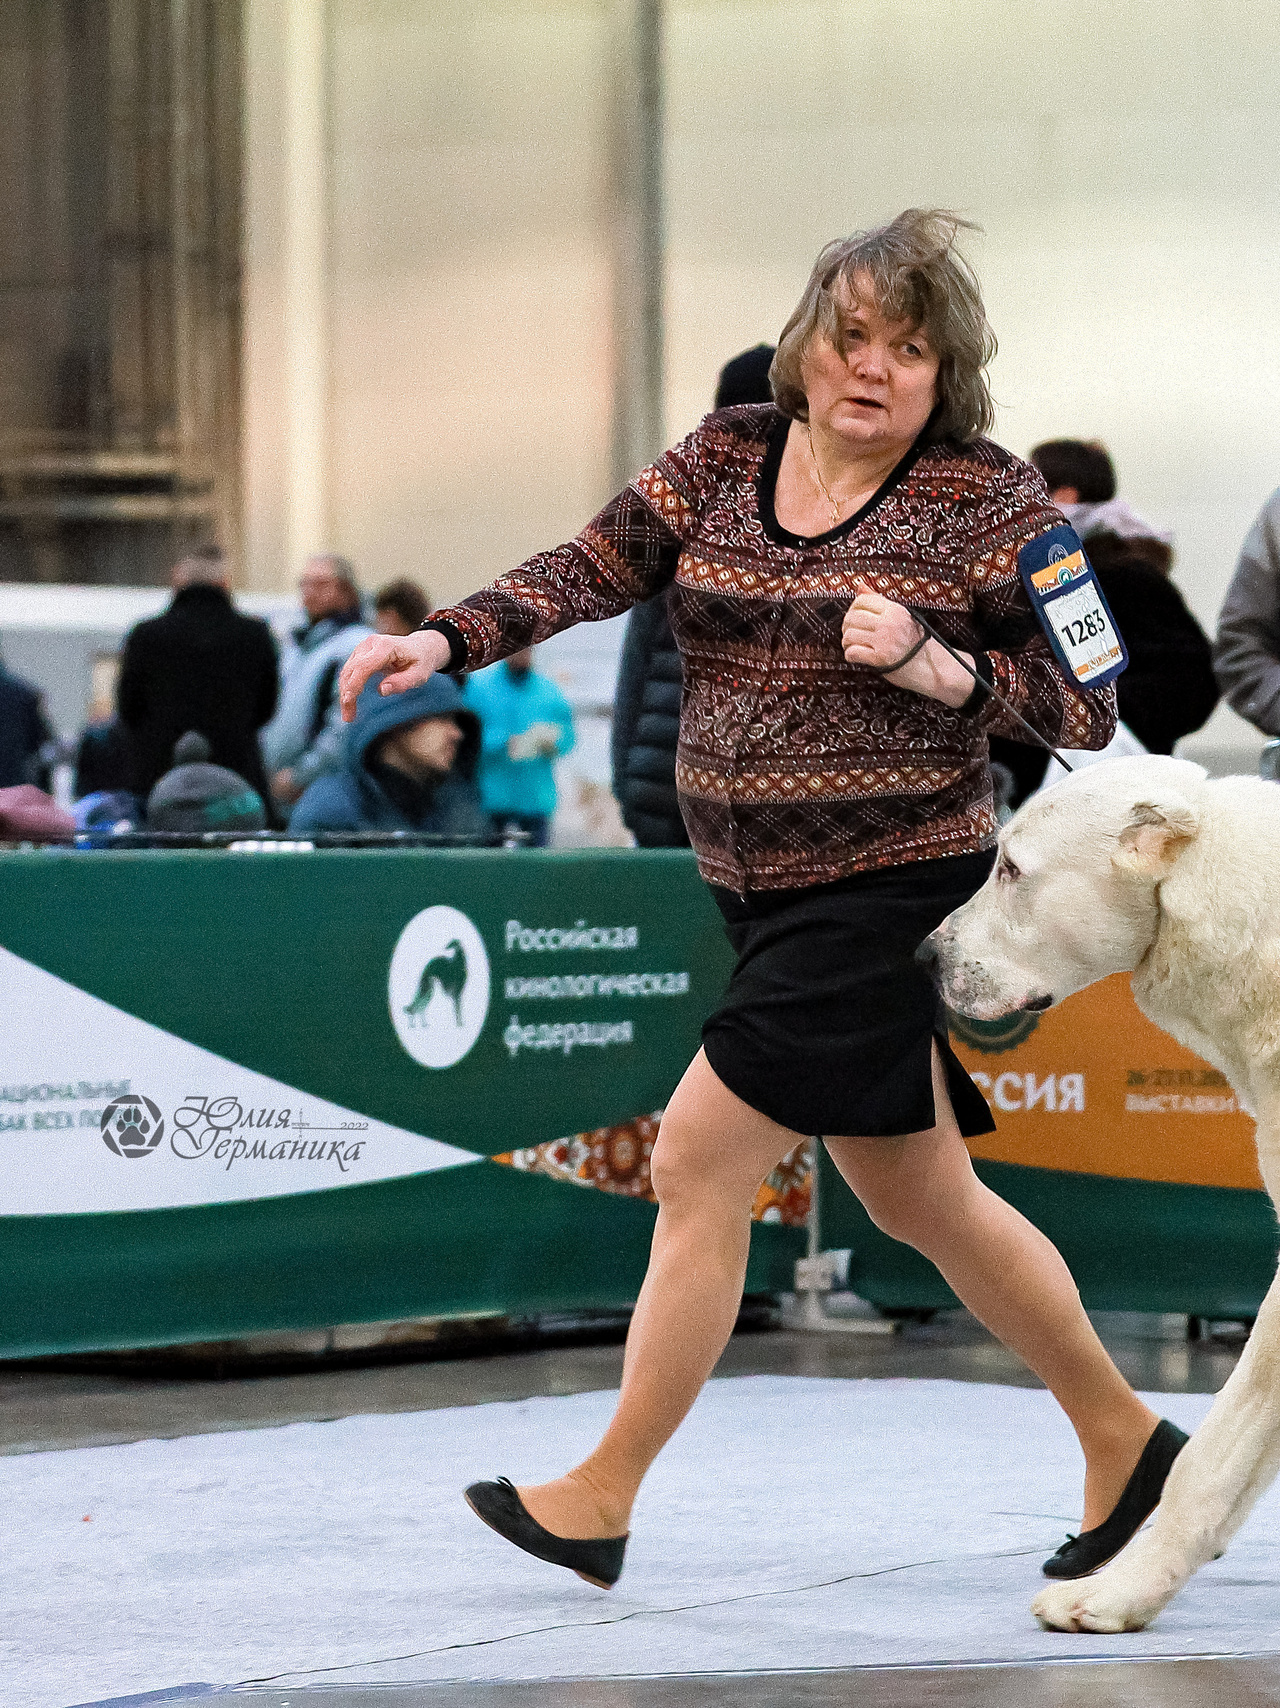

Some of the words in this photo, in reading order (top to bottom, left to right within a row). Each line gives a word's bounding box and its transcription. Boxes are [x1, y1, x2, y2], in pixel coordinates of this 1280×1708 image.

[1061, 608, 1106, 648] 1283
[505, 919, 638, 951] Российская
[505, 972, 690, 999] кинологическая
[504, 1014, 633, 1057] федерация
